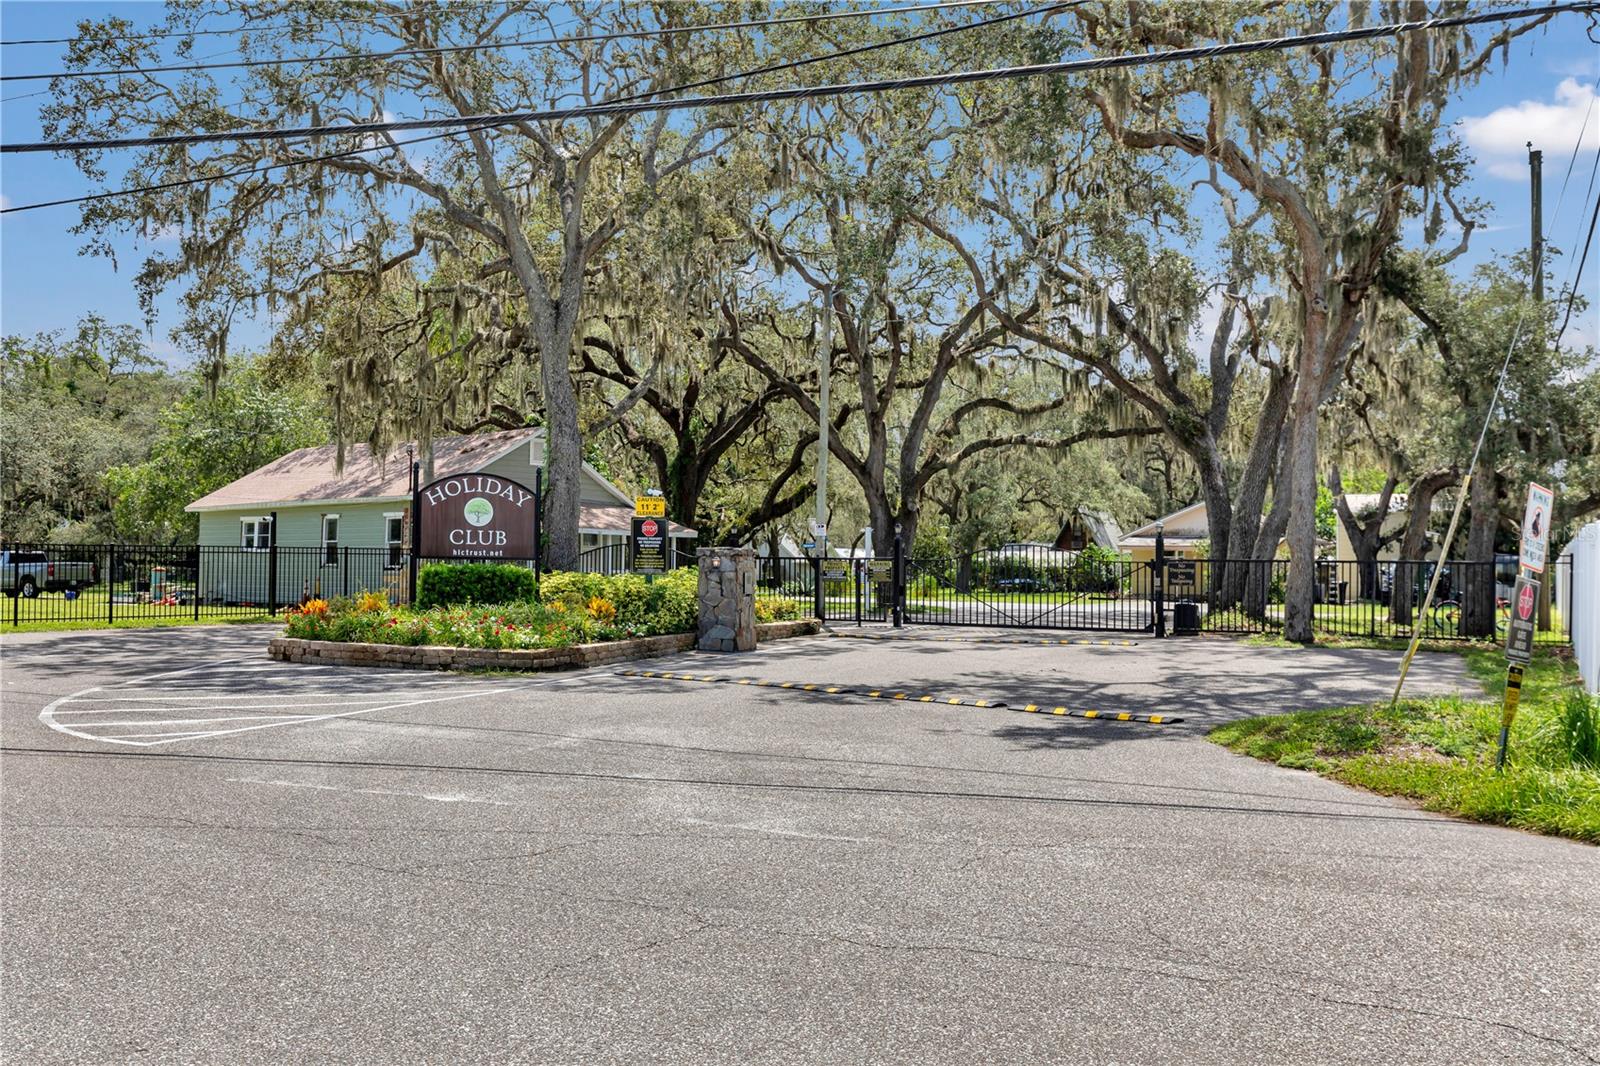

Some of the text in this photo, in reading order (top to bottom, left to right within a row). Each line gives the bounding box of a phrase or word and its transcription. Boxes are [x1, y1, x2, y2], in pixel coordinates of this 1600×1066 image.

[425, 477, 532, 507] HOLIDAY
[449, 529, 507, 546] CLUB
[1519, 596, 1534, 608] STOP
